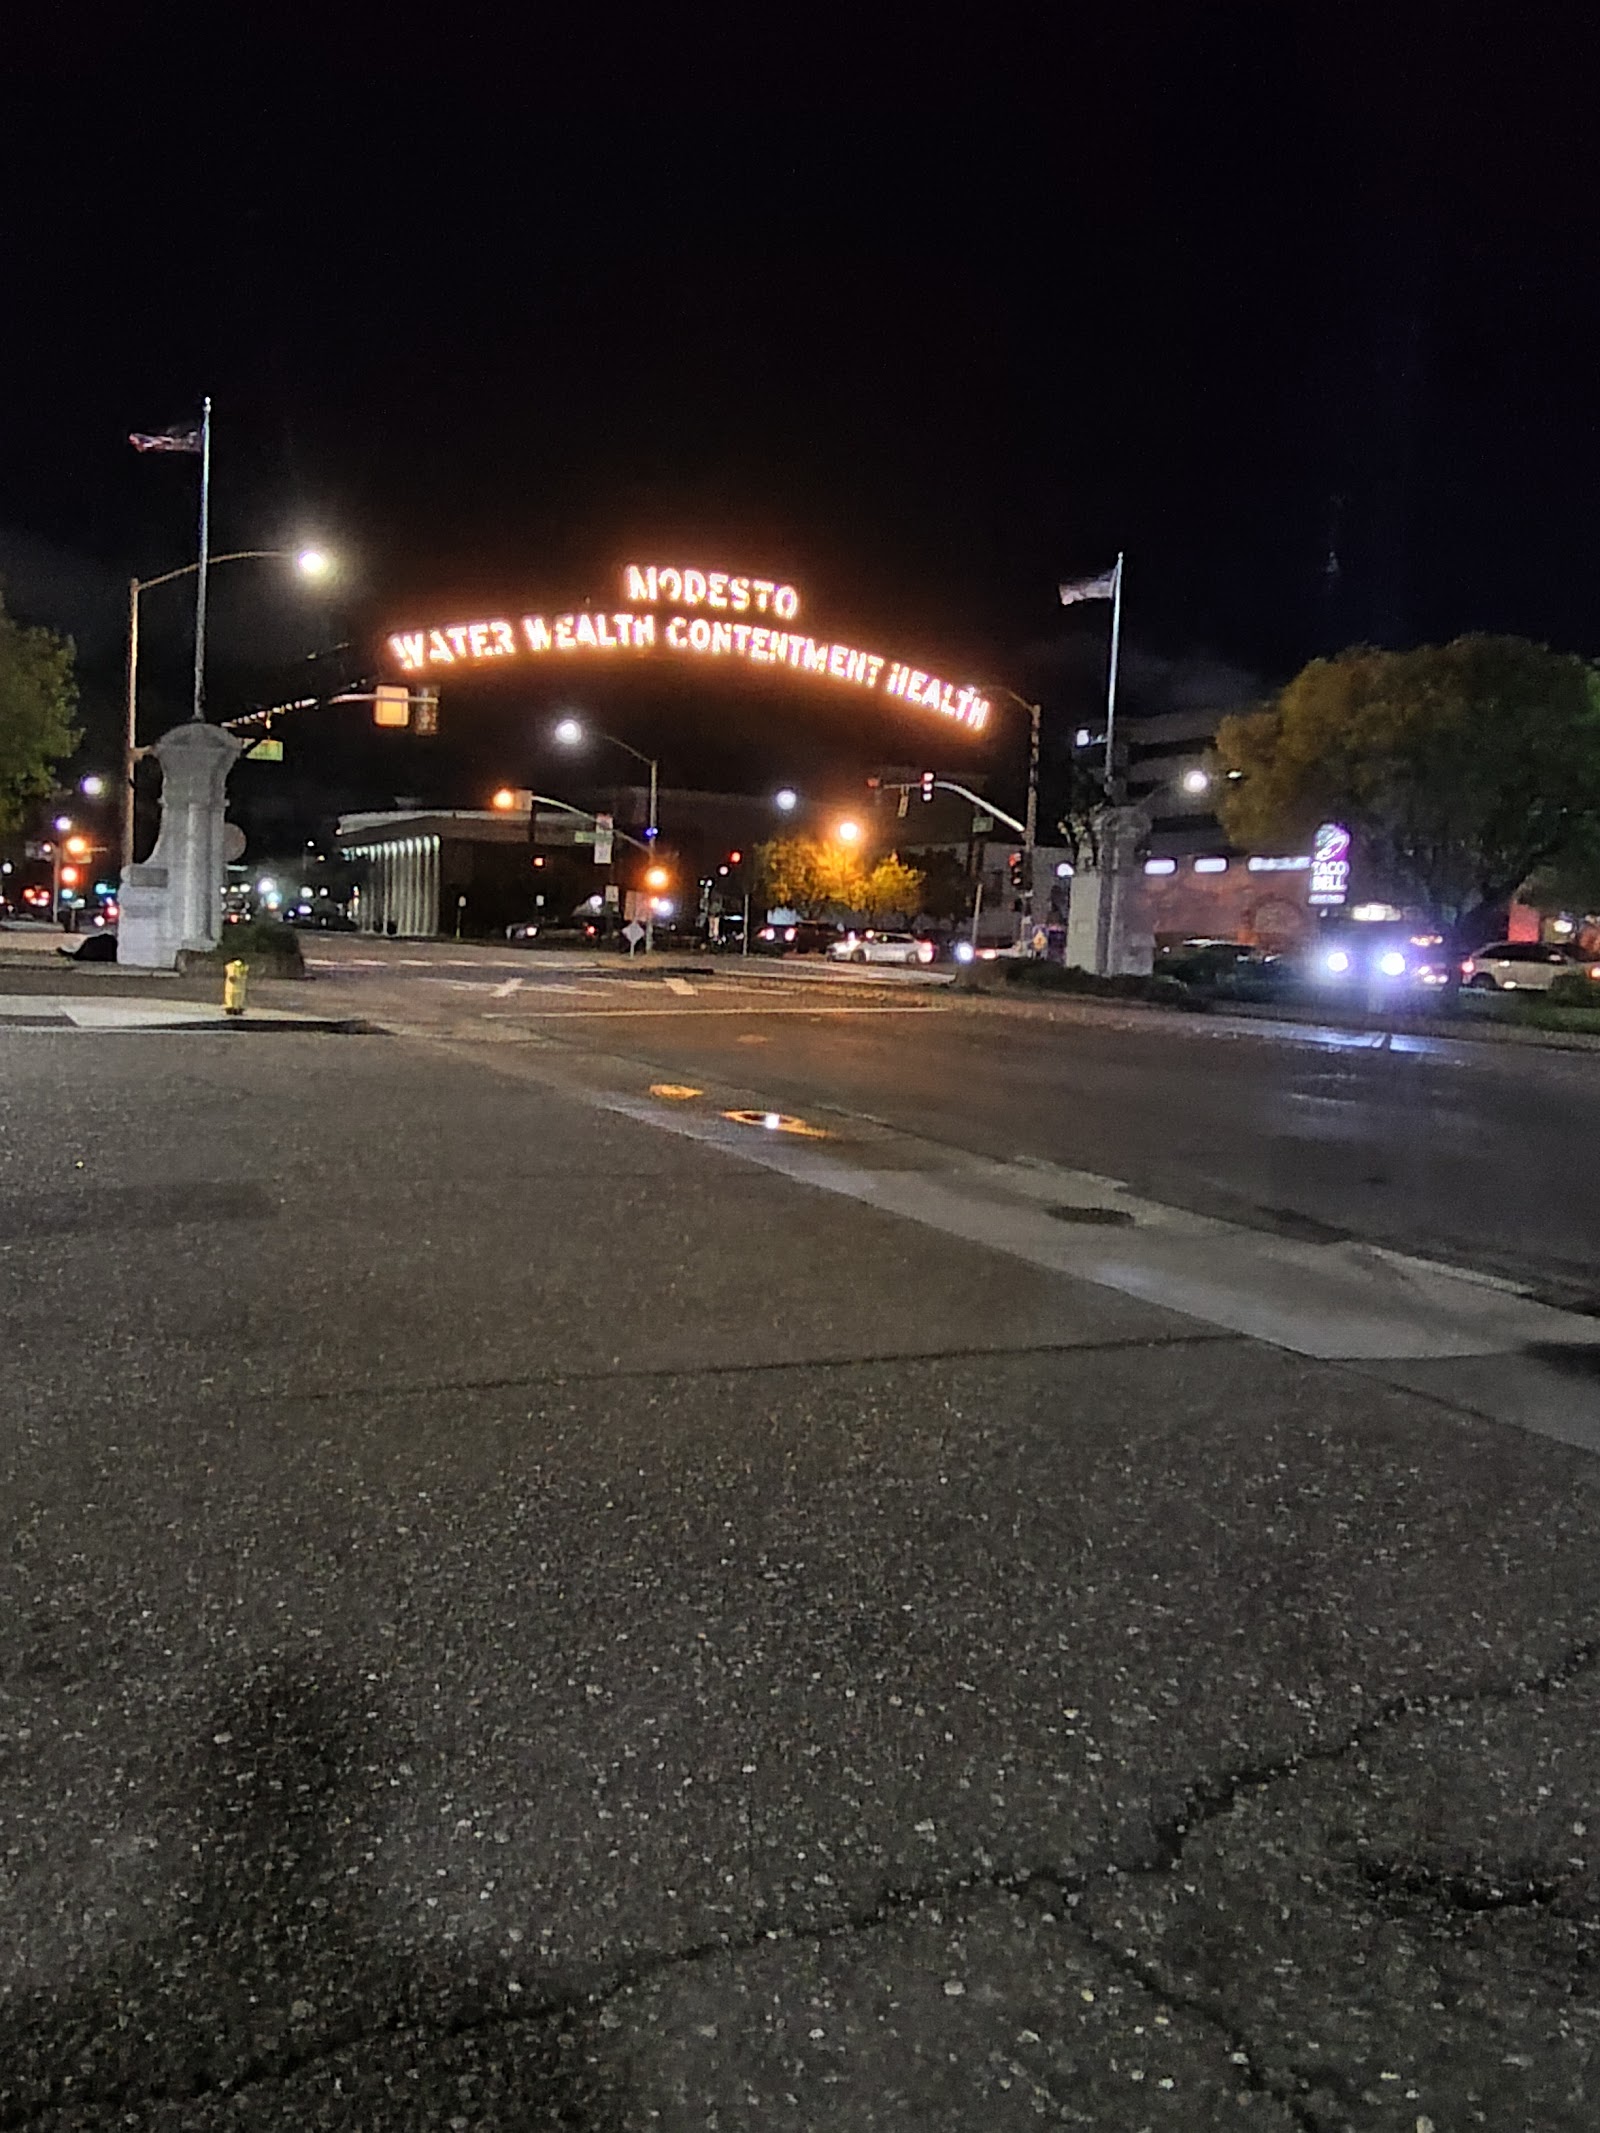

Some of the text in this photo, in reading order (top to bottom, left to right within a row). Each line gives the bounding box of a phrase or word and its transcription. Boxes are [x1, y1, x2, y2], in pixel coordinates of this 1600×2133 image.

[625, 565, 799, 619] MODESTO
[389, 613, 989, 730] WATER WEALTH CONTENTMENT HEALTH
[1310, 861, 1347, 876] TACO
[1311, 876, 1347, 891] BELL
